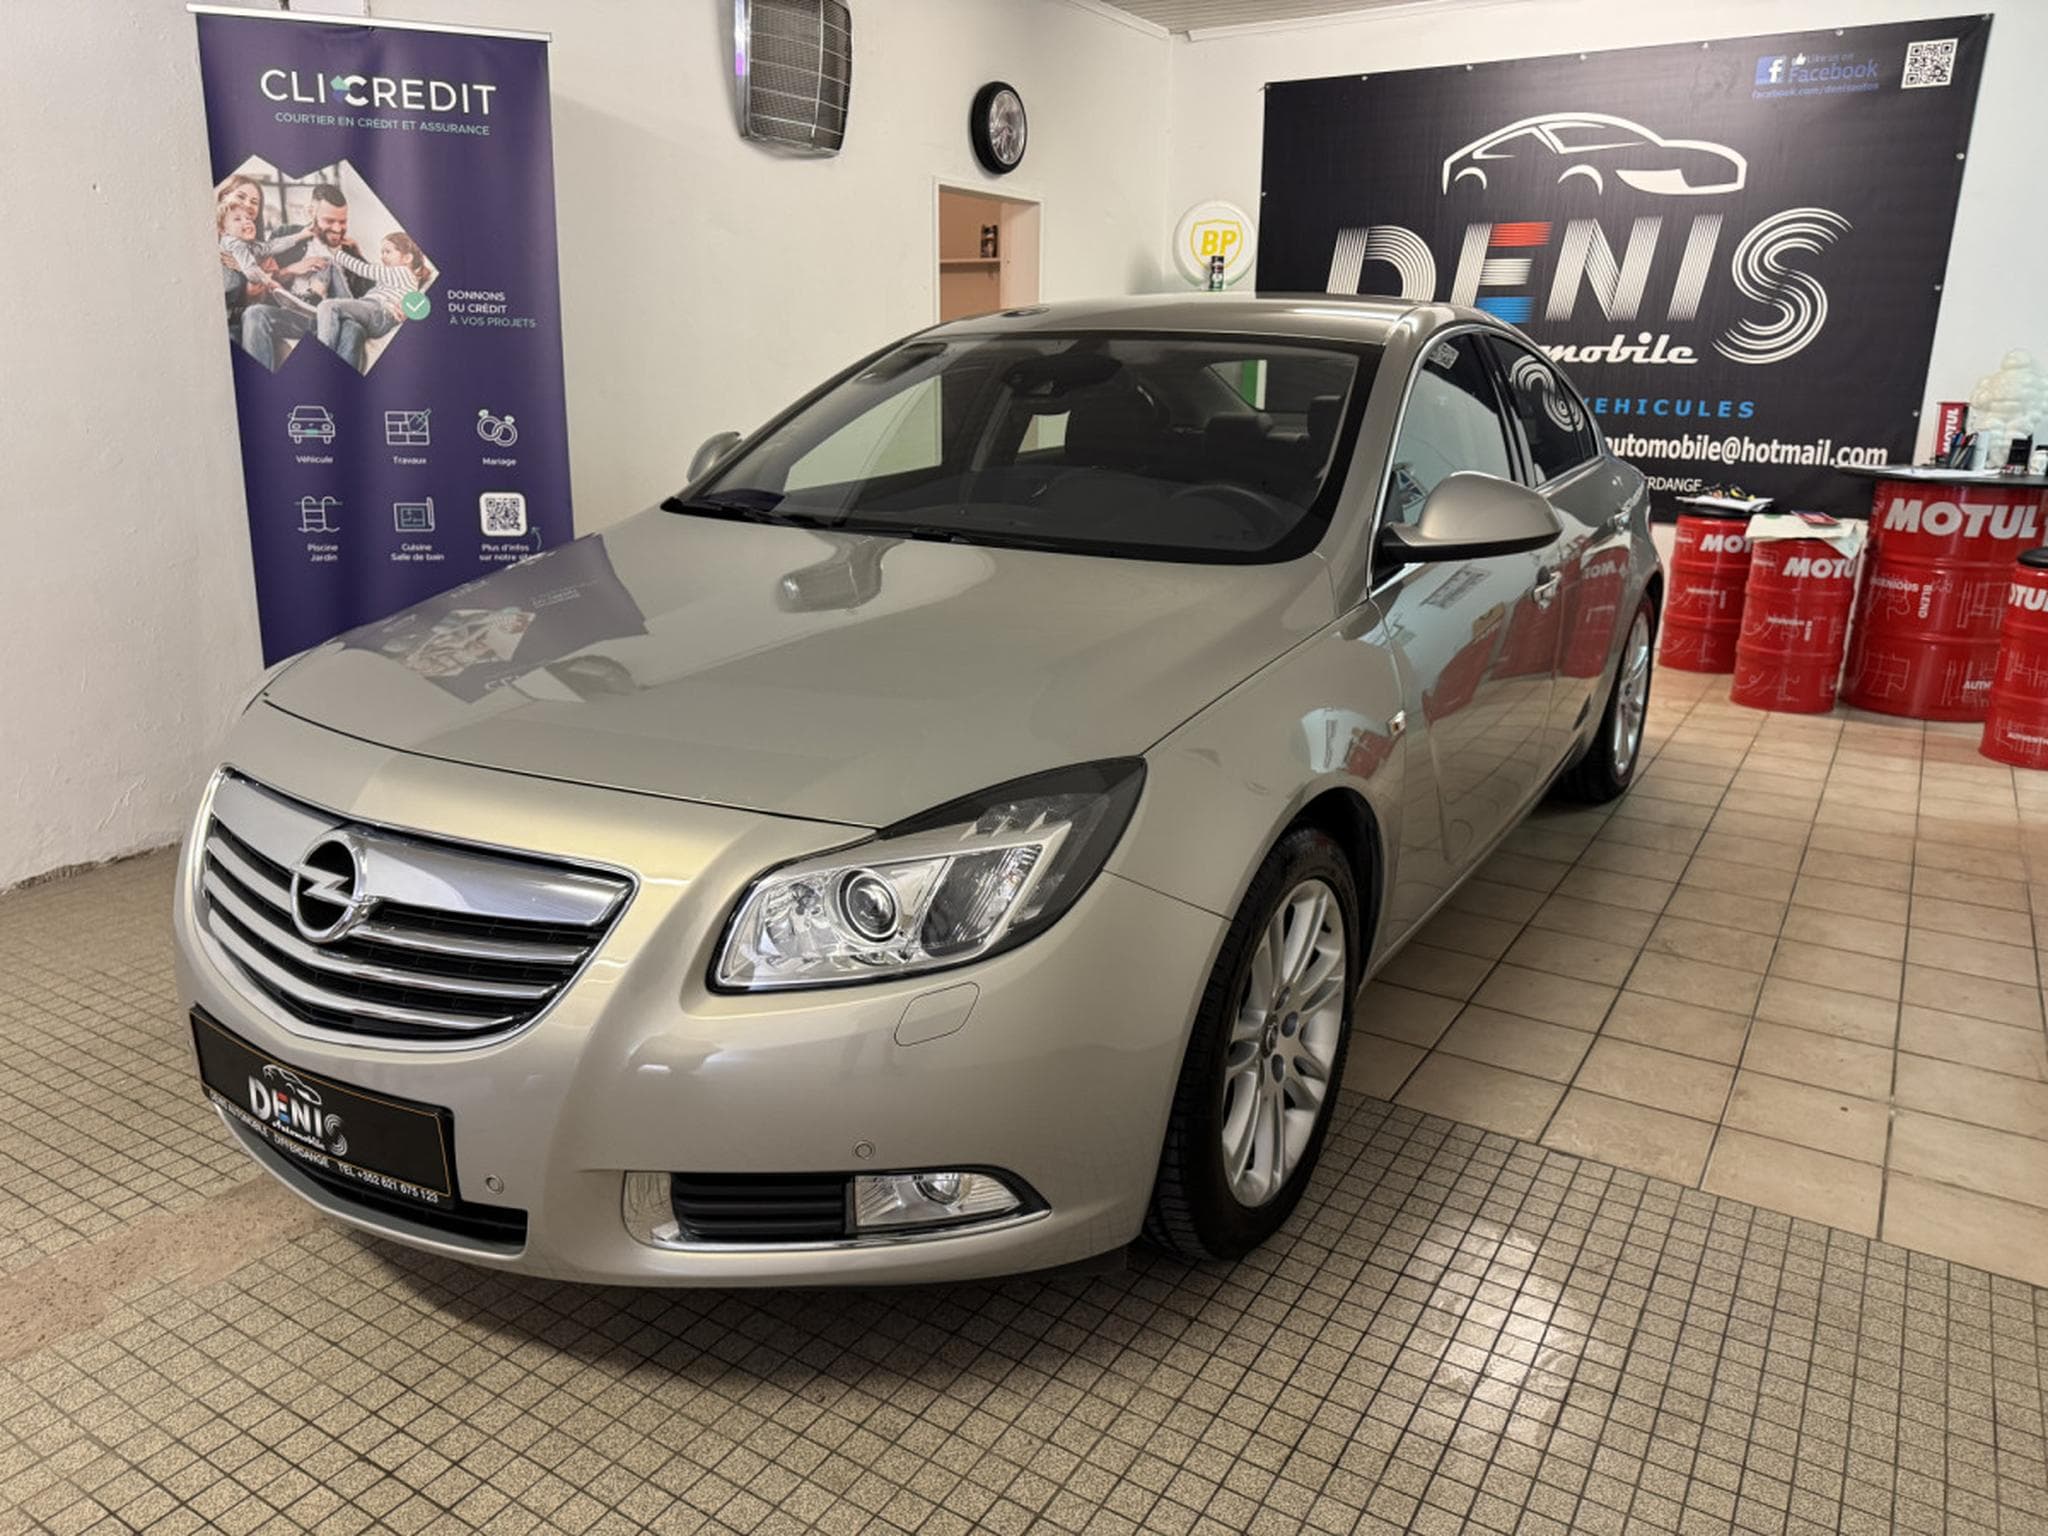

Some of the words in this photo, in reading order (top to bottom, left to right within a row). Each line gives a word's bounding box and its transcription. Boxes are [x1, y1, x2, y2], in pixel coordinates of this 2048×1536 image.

[1788, 60, 1878, 82] Facebook
[274, 112, 336, 126] COURTIER
[337, 116, 355, 127] EN
[402, 120, 416, 130] ET
[419, 121, 491, 136] ASSURANCE
[1201, 229, 1238, 257] BP
[1326, 207, 1854, 364] DENIS
[447, 289, 506, 301] DONNONS
[447, 302, 465, 313] DU
[461, 316, 485, 326] VOS
[487, 316, 537, 328] PROJETS
[1942, 408, 1959, 453] MOTUL
[295, 455, 334, 464] Véhicule
[393, 456, 427, 465] Travaux
[482, 457, 517, 467] Mariage
[1883, 498, 2039, 540] MOTUL
[307, 543, 339, 552] Piscine
[401, 543, 432, 552] Cuisine
[481, 543, 499, 552] Plus
[501, 543, 529, 552] d'infos
[309, 552, 338, 562] Jardin
[390, 553, 411, 561] Salle
[413, 553, 423, 561] de
[425, 553, 445, 561] bain
[494, 553, 516, 561] notre
[2008, 582, 2048, 613] TU
[248, 1075, 348, 1157] DENIS
